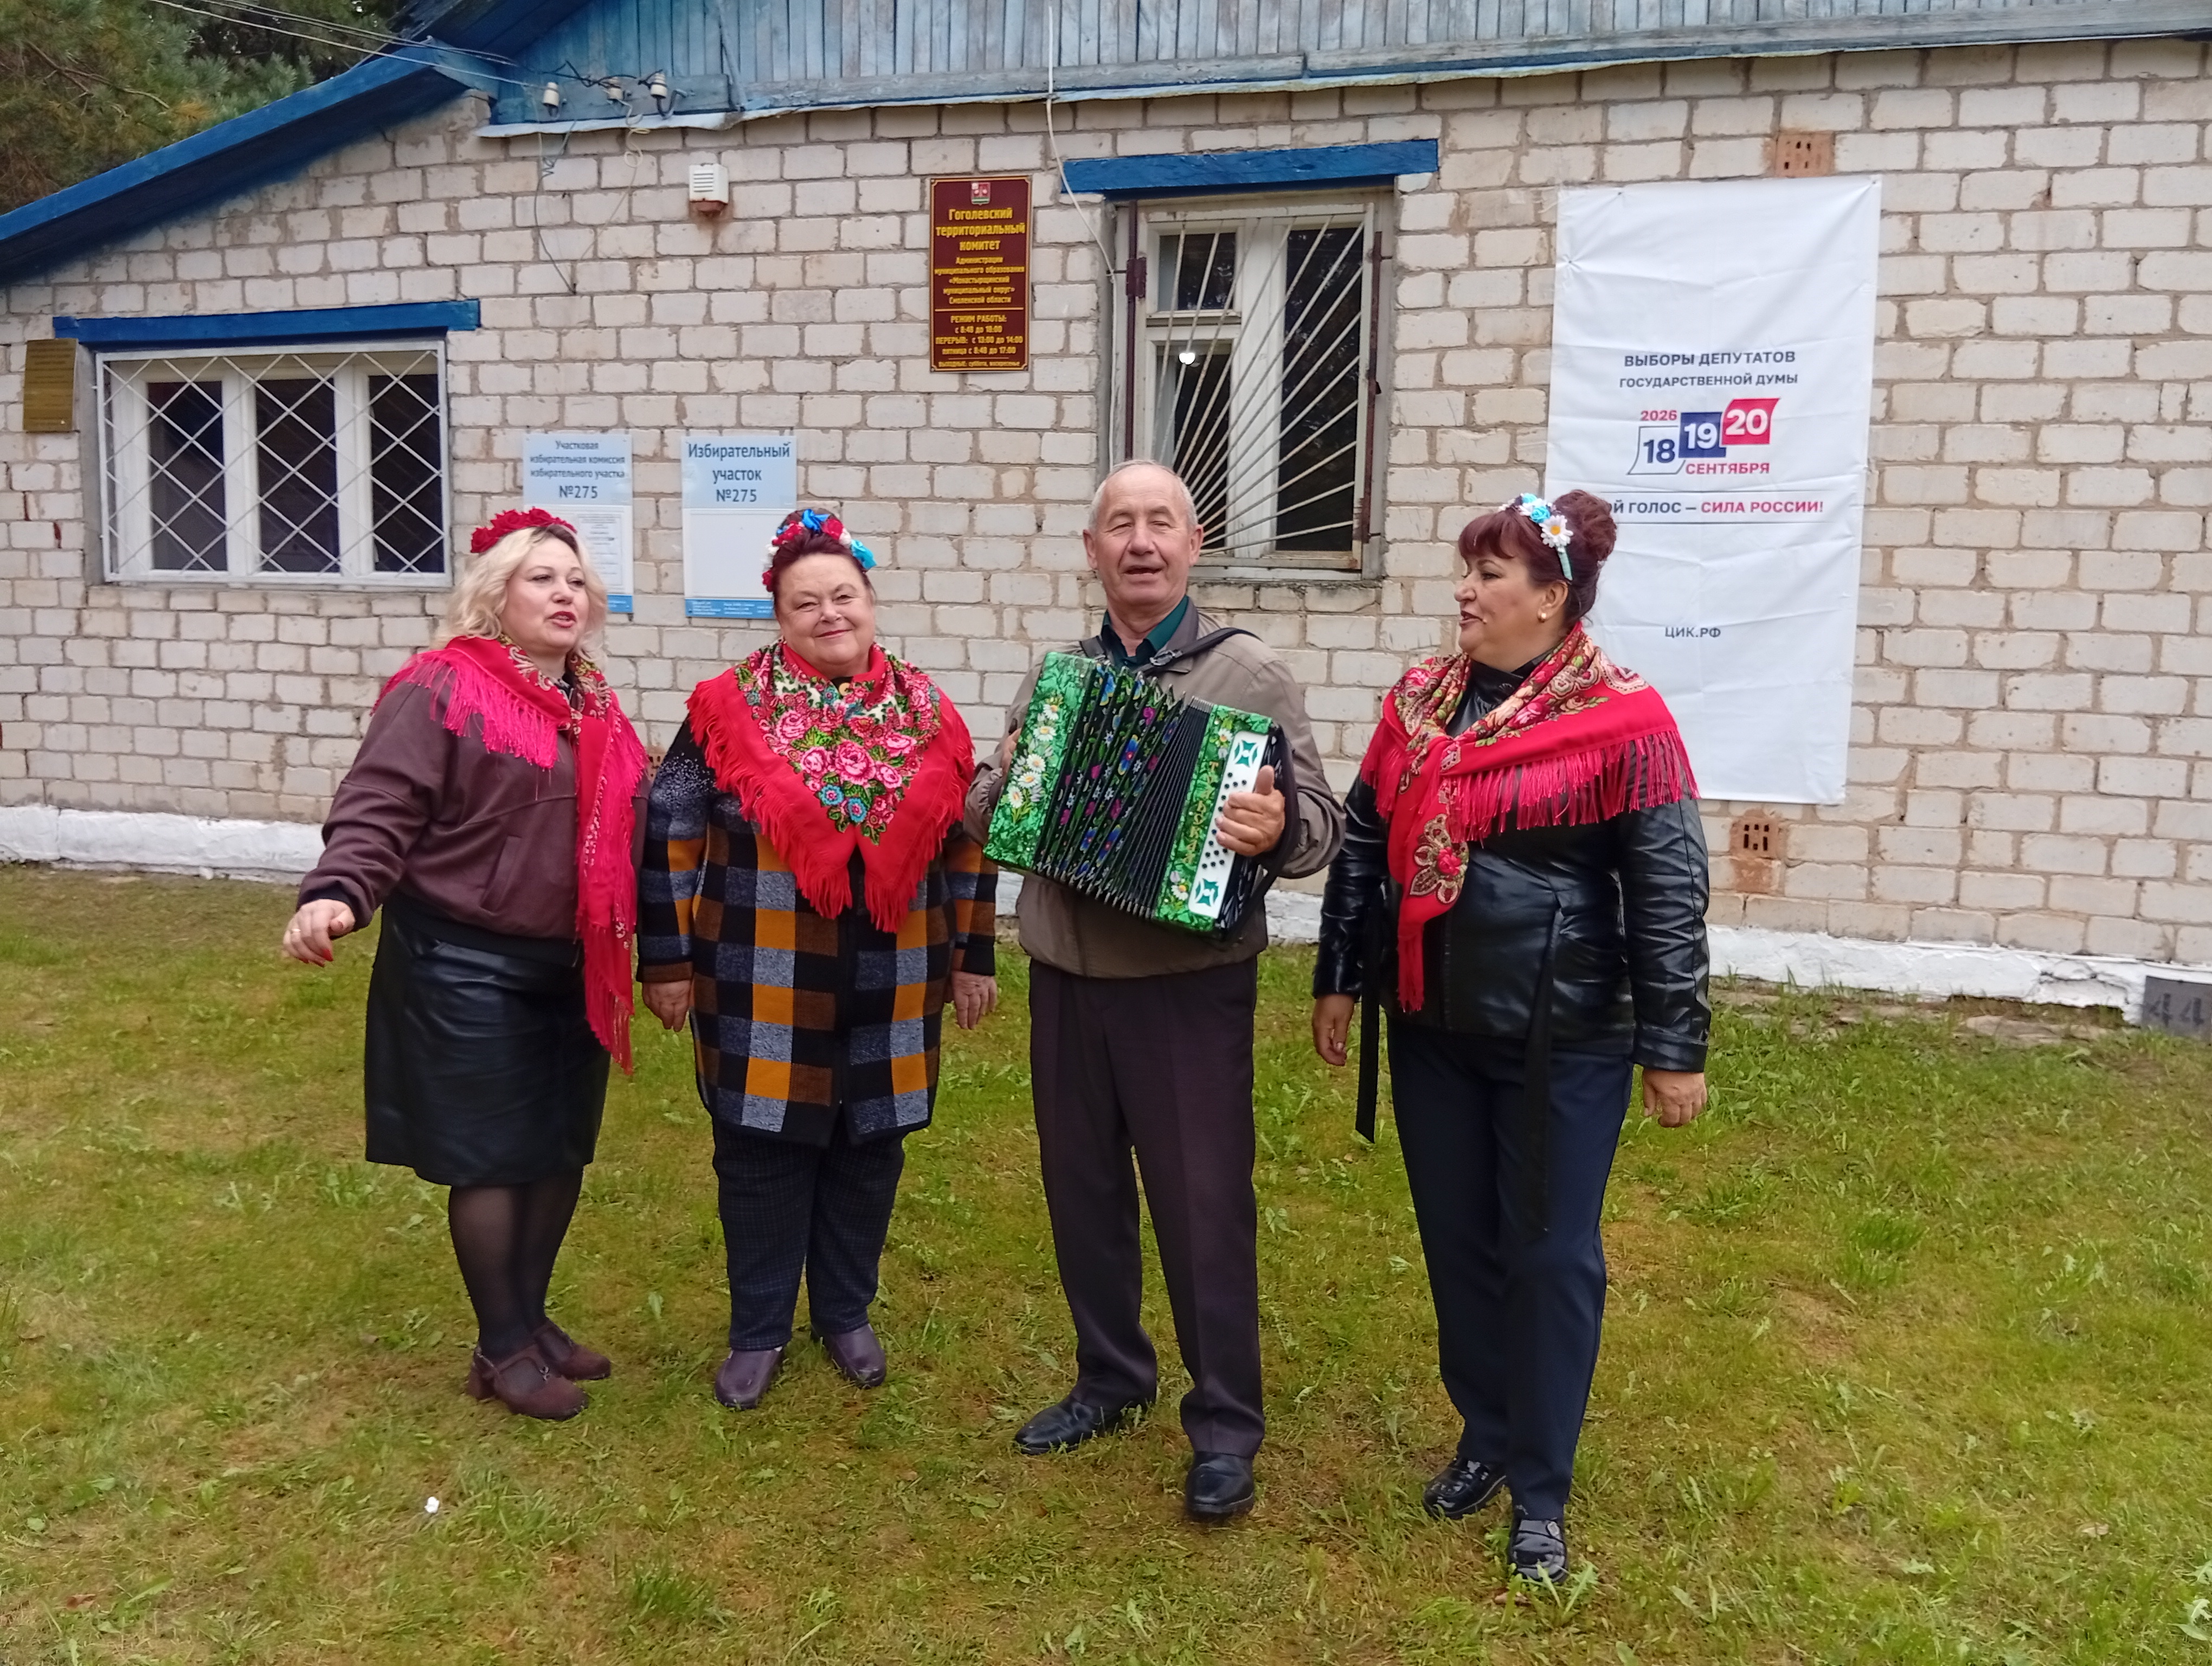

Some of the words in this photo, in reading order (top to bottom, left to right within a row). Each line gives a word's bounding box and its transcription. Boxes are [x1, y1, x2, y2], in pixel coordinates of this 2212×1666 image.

[949, 208, 1013, 220] Гоголевский
[936, 222, 1025, 238] территориальный
[959, 240, 1000, 251] комитет
[950, 315, 975, 323] РЕЖИМ
[935, 336, 968, 344] ПЕРЕРЫВ:
[1624, 354, 1694, 367] ВЫБОРЫ
[1699, 351, 1796, 366] ДЕПУТАТОВ
[1619, 373, 1752, 388] ГОСУДАРСТВЕННОЙ
[1756, 374, 1798, 386] ДУМЫ
[1641, 410, 1677, 421] 2026
[1643, 439, 1675, 464] 18
[1684, 422, 1718, 450] 19
[1725, 408, 1769, 435] 20
[555, 440, 599, 450] Участковая
[688, 443, 790, 461] Избирательный
[530, 454, 587, 465] избирательная
[530, 467, 593, 479] избирательного
[594, 471, 625, 480] участка
[1686, 463, 1770, 475] СЕНТЯБРЯ
[712, 470, 762, 484] участок
[559, 485, 598, 498] №275
[716, 489, 757, 502] №275
[1629, 502, 1682, 514] ГОЛОС
[1701, 502, 1746, 513] СИЛА
[1750, 501, 1823, 513] РОССИИ!
[1665, 627, 1721, 638] ЦИК.РФ
